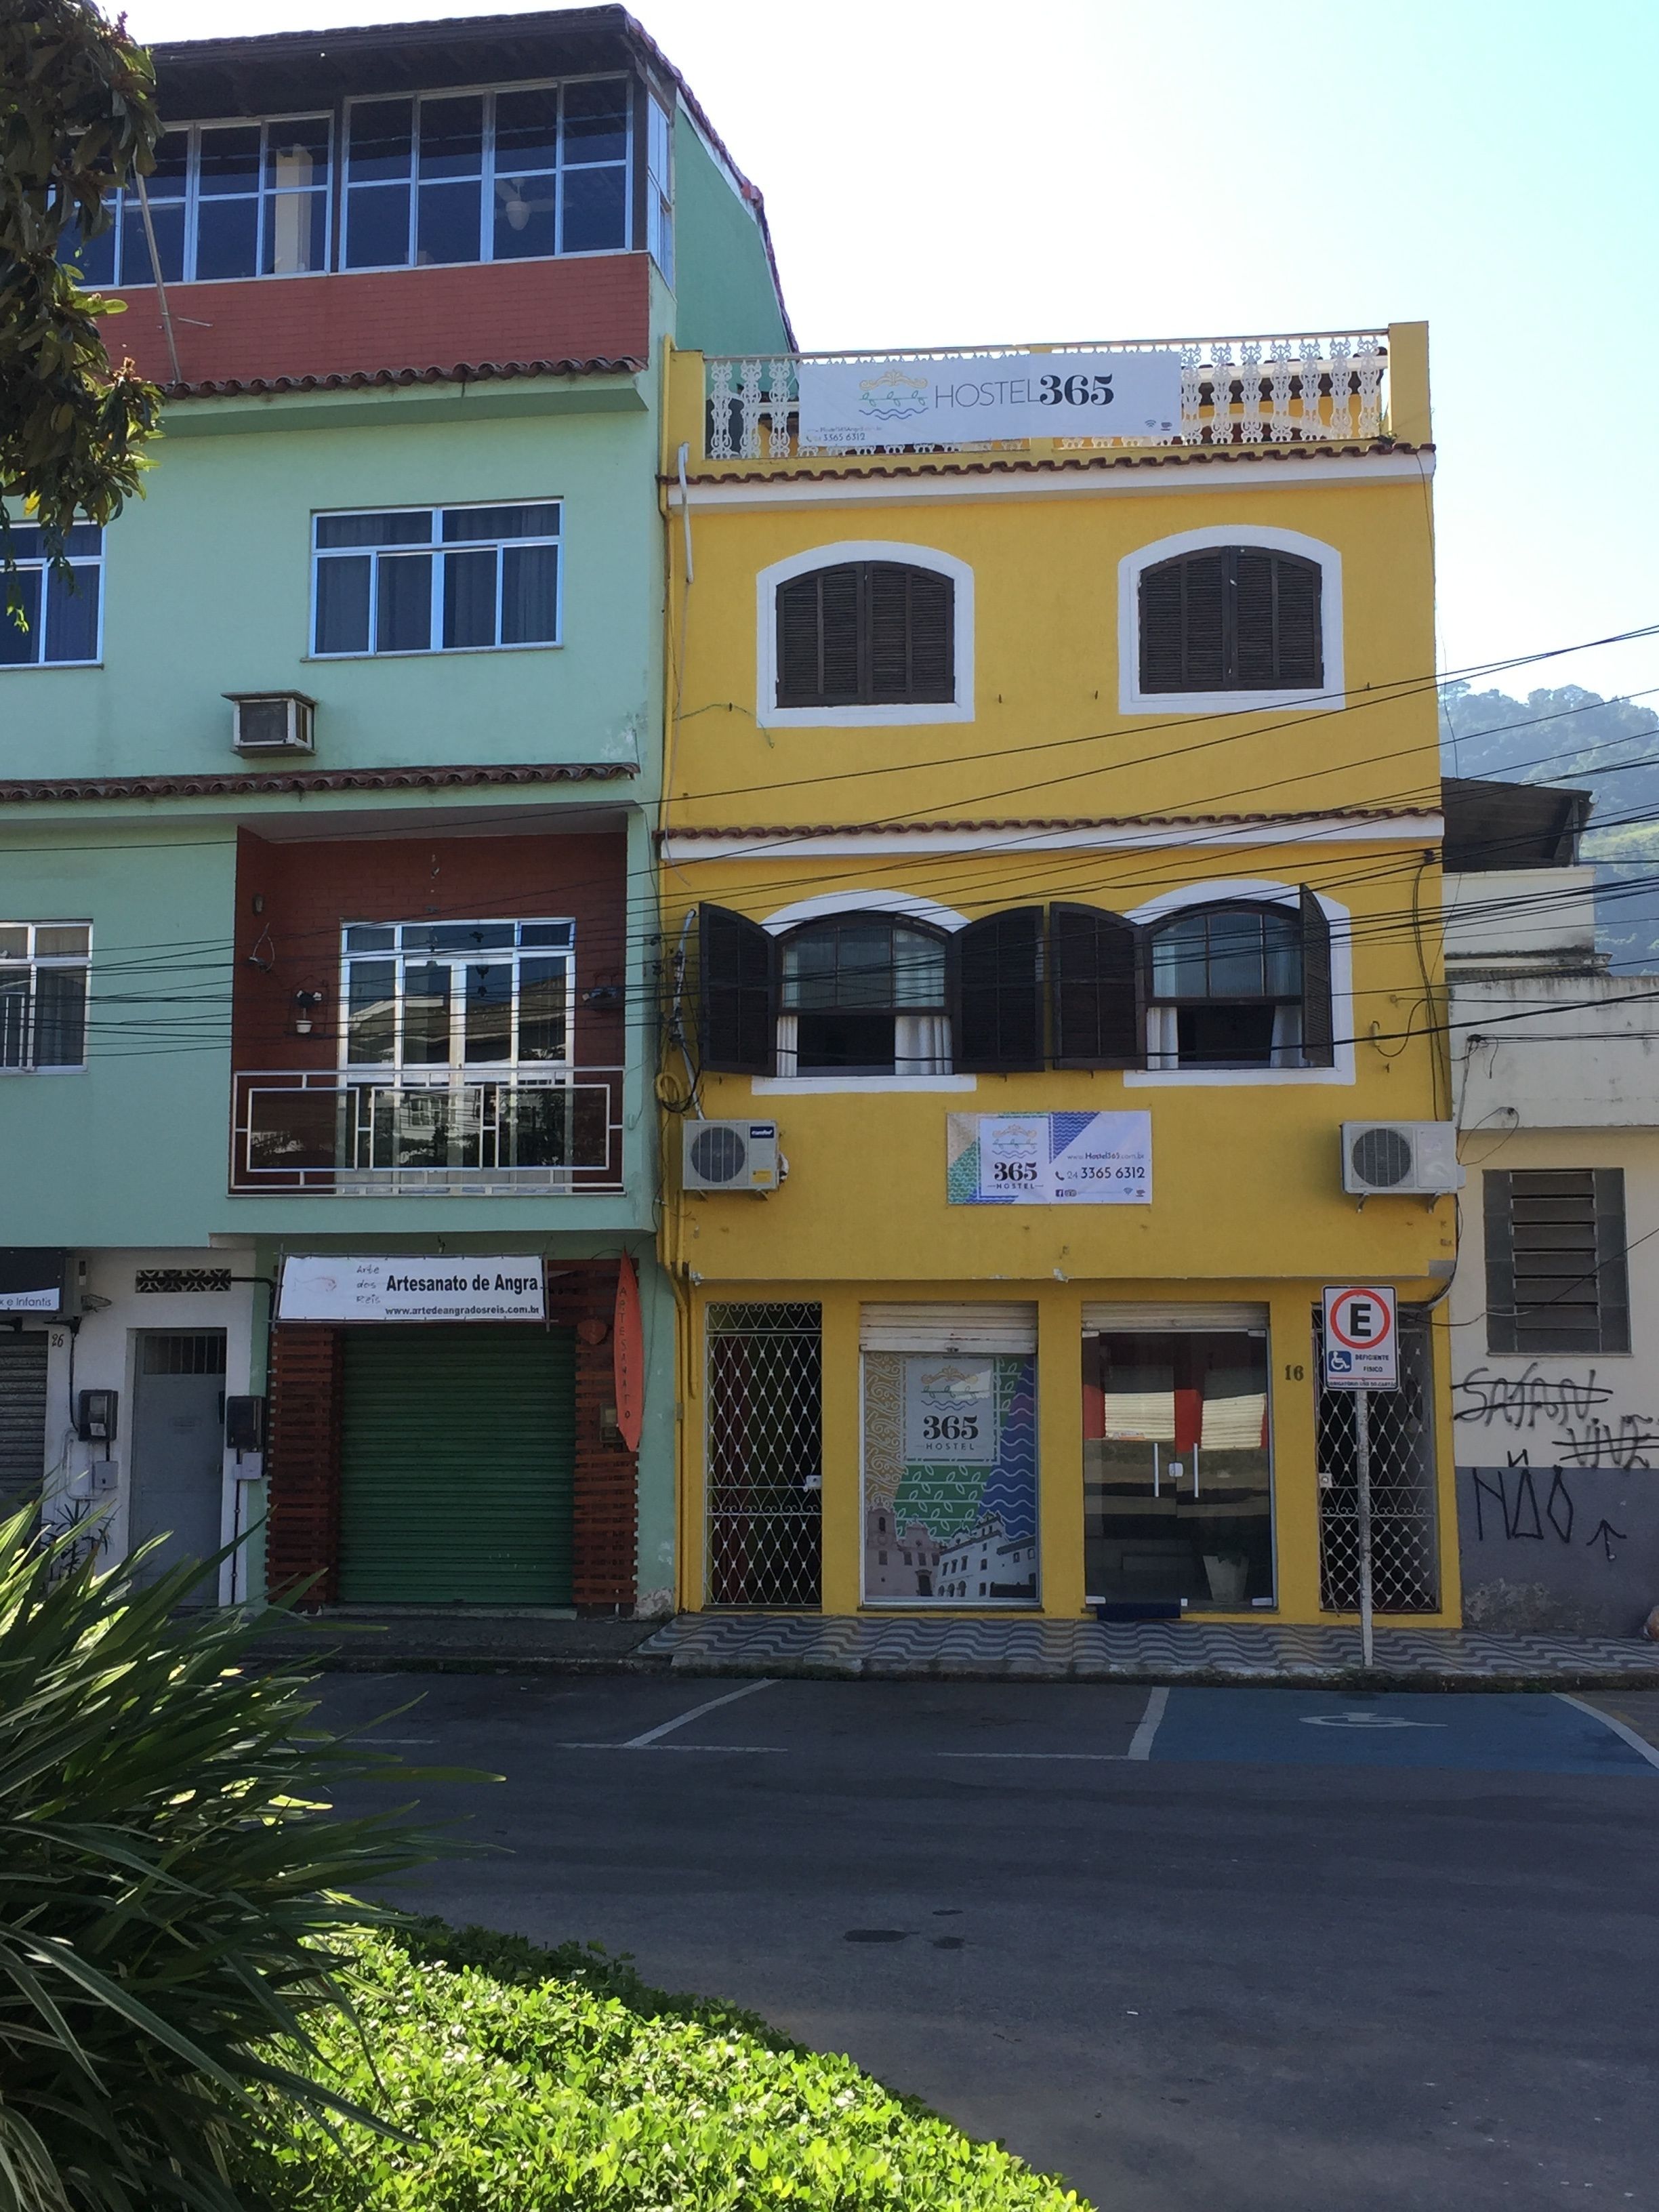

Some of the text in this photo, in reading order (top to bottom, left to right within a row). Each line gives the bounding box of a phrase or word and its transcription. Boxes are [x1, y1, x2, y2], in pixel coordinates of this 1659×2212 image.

[994, 1162, 1038, 1181] 365
[1081, 1167, 1111, 1179] 3365
[1115, 1166, 1145, 1179] 6312
[356, 1264, 380, 1274] Arte
[386, 1274, 538, 1295] Artesanato de Angra
[16, 1296, 52, 1307] Infantis
[1350, 1303, 1372, 1336] E
[1285, 1365, 1304, 1381] 16
[924, 1415, 979, 1439] 365
